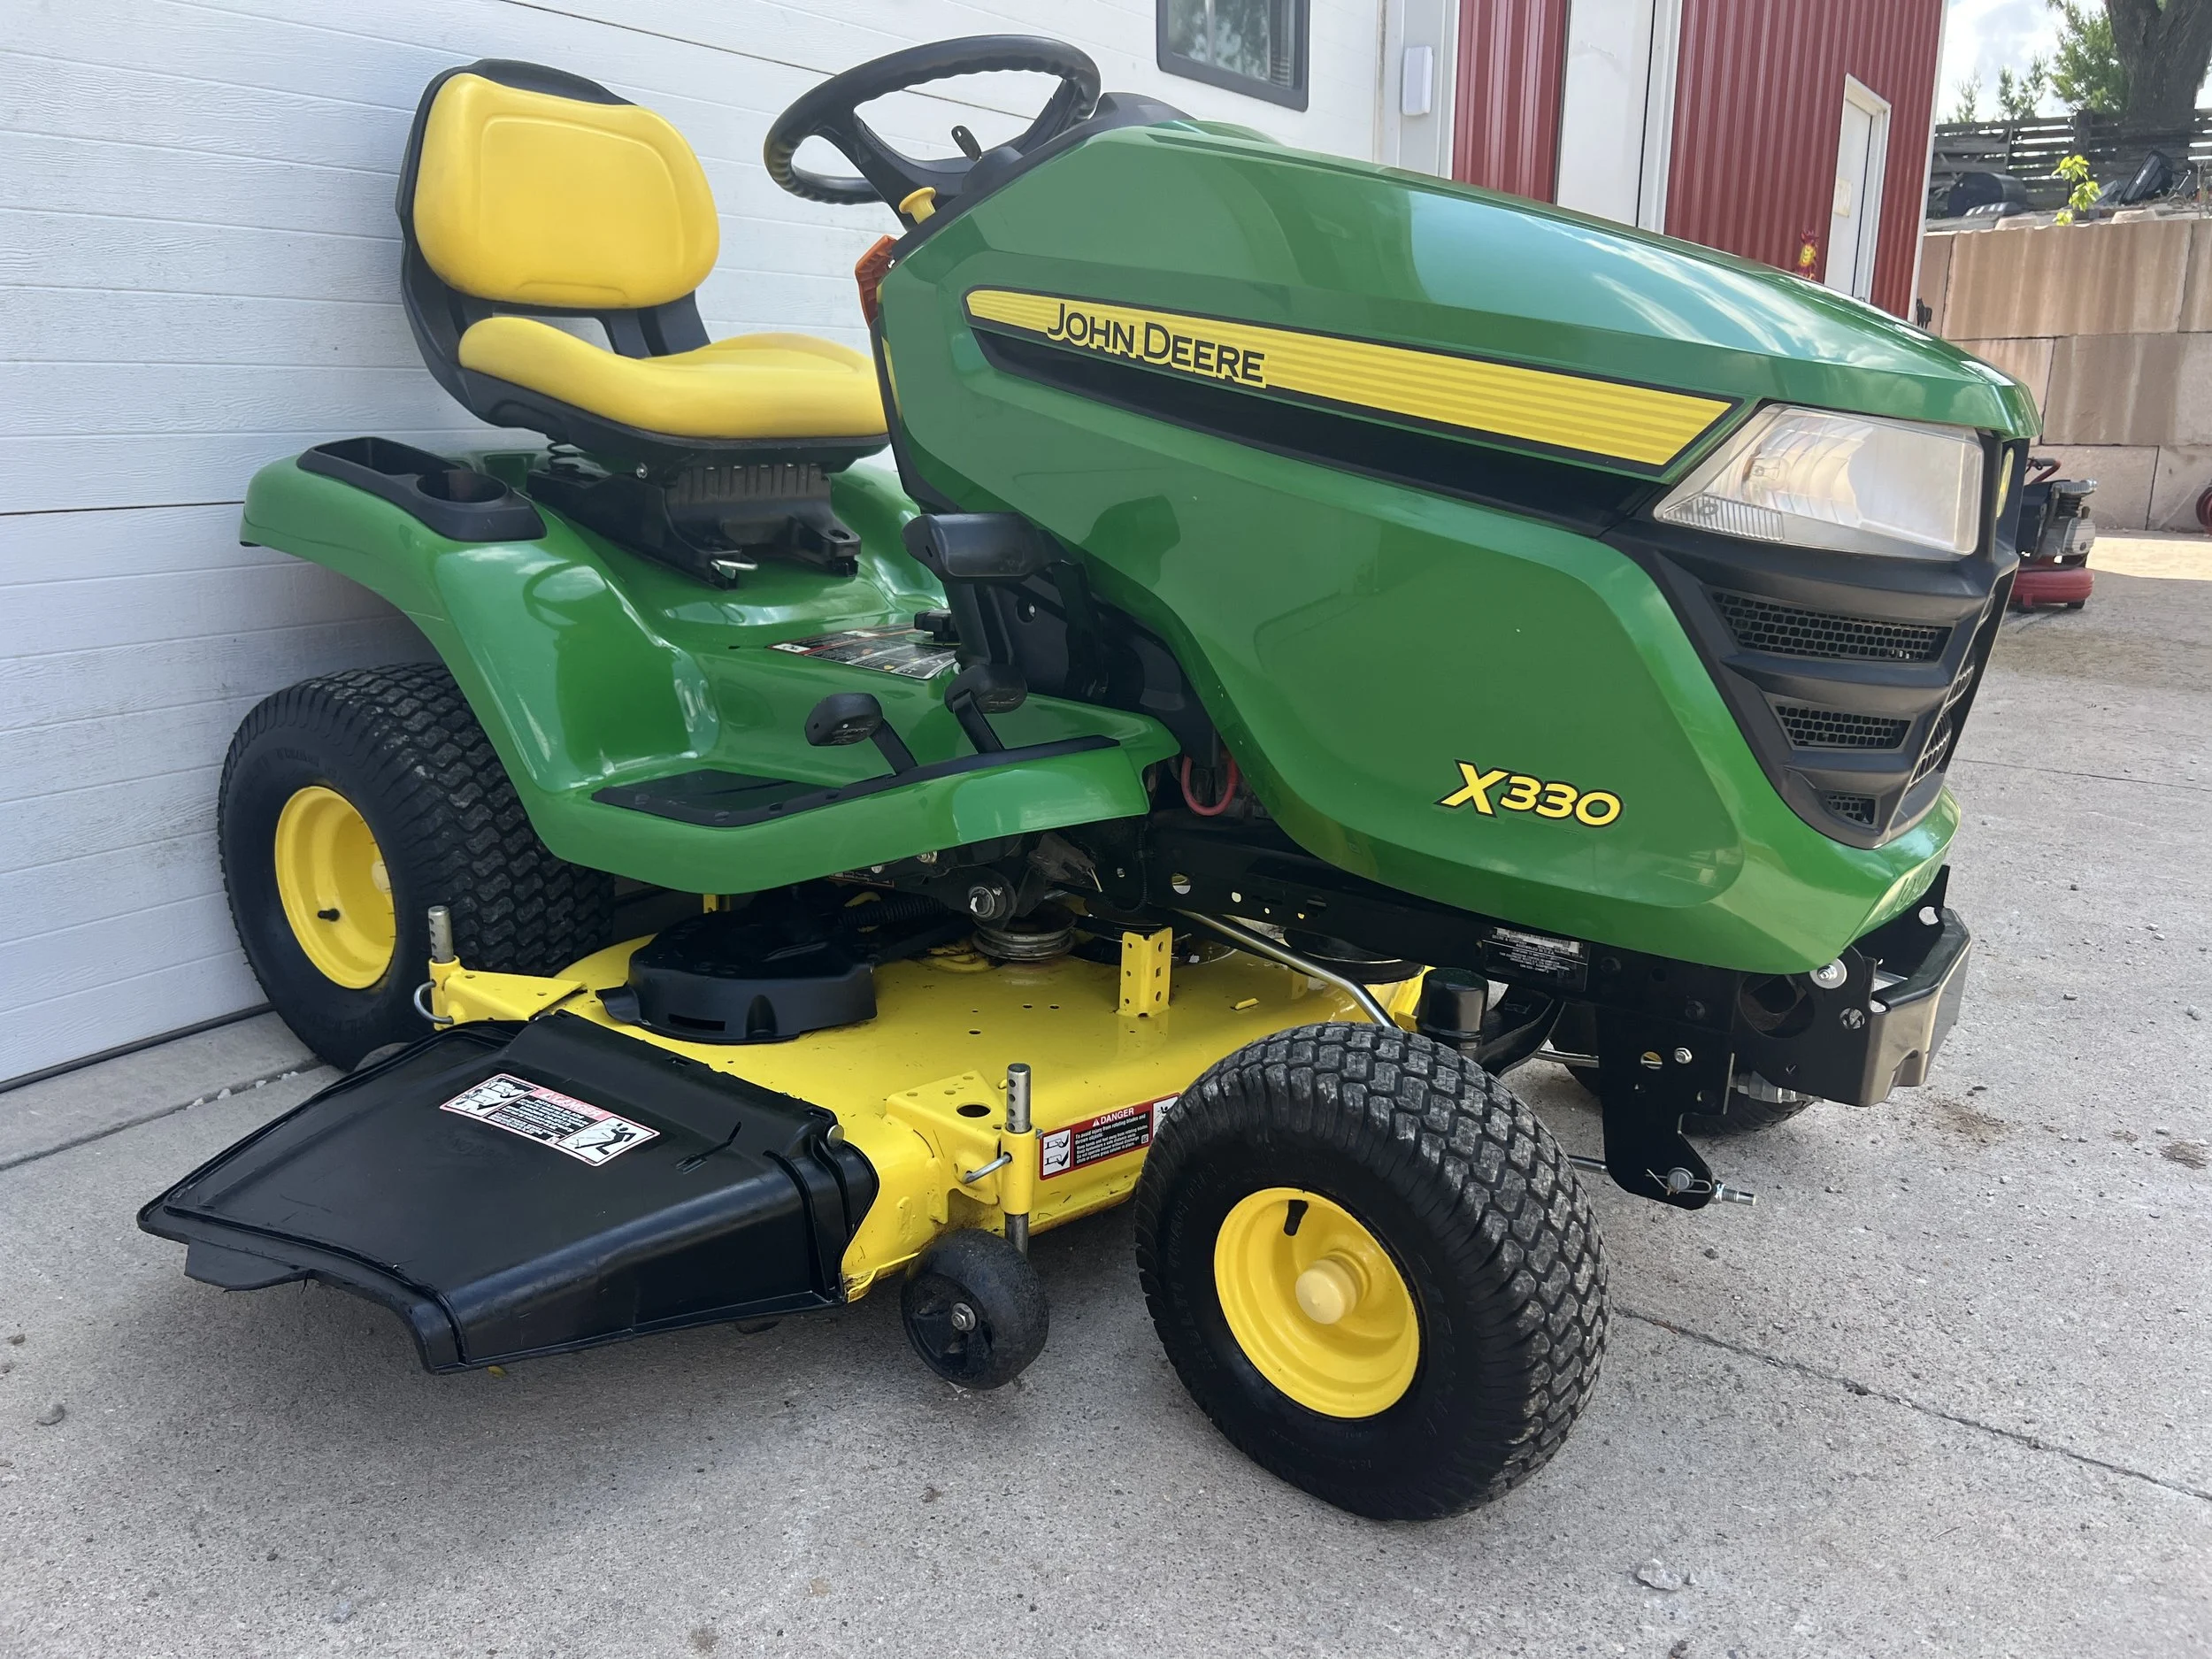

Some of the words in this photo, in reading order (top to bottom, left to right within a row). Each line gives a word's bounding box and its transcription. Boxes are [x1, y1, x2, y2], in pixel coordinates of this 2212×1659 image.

[1048, 303, 1135, 355] JOHN
[1144, 321, 1265, 383] DEERE
[1436, 761, 1623, 827] X330
[552, 1094, 603, 1116] DANGER
[1101, 1108, 1134, 1124] DANGER
